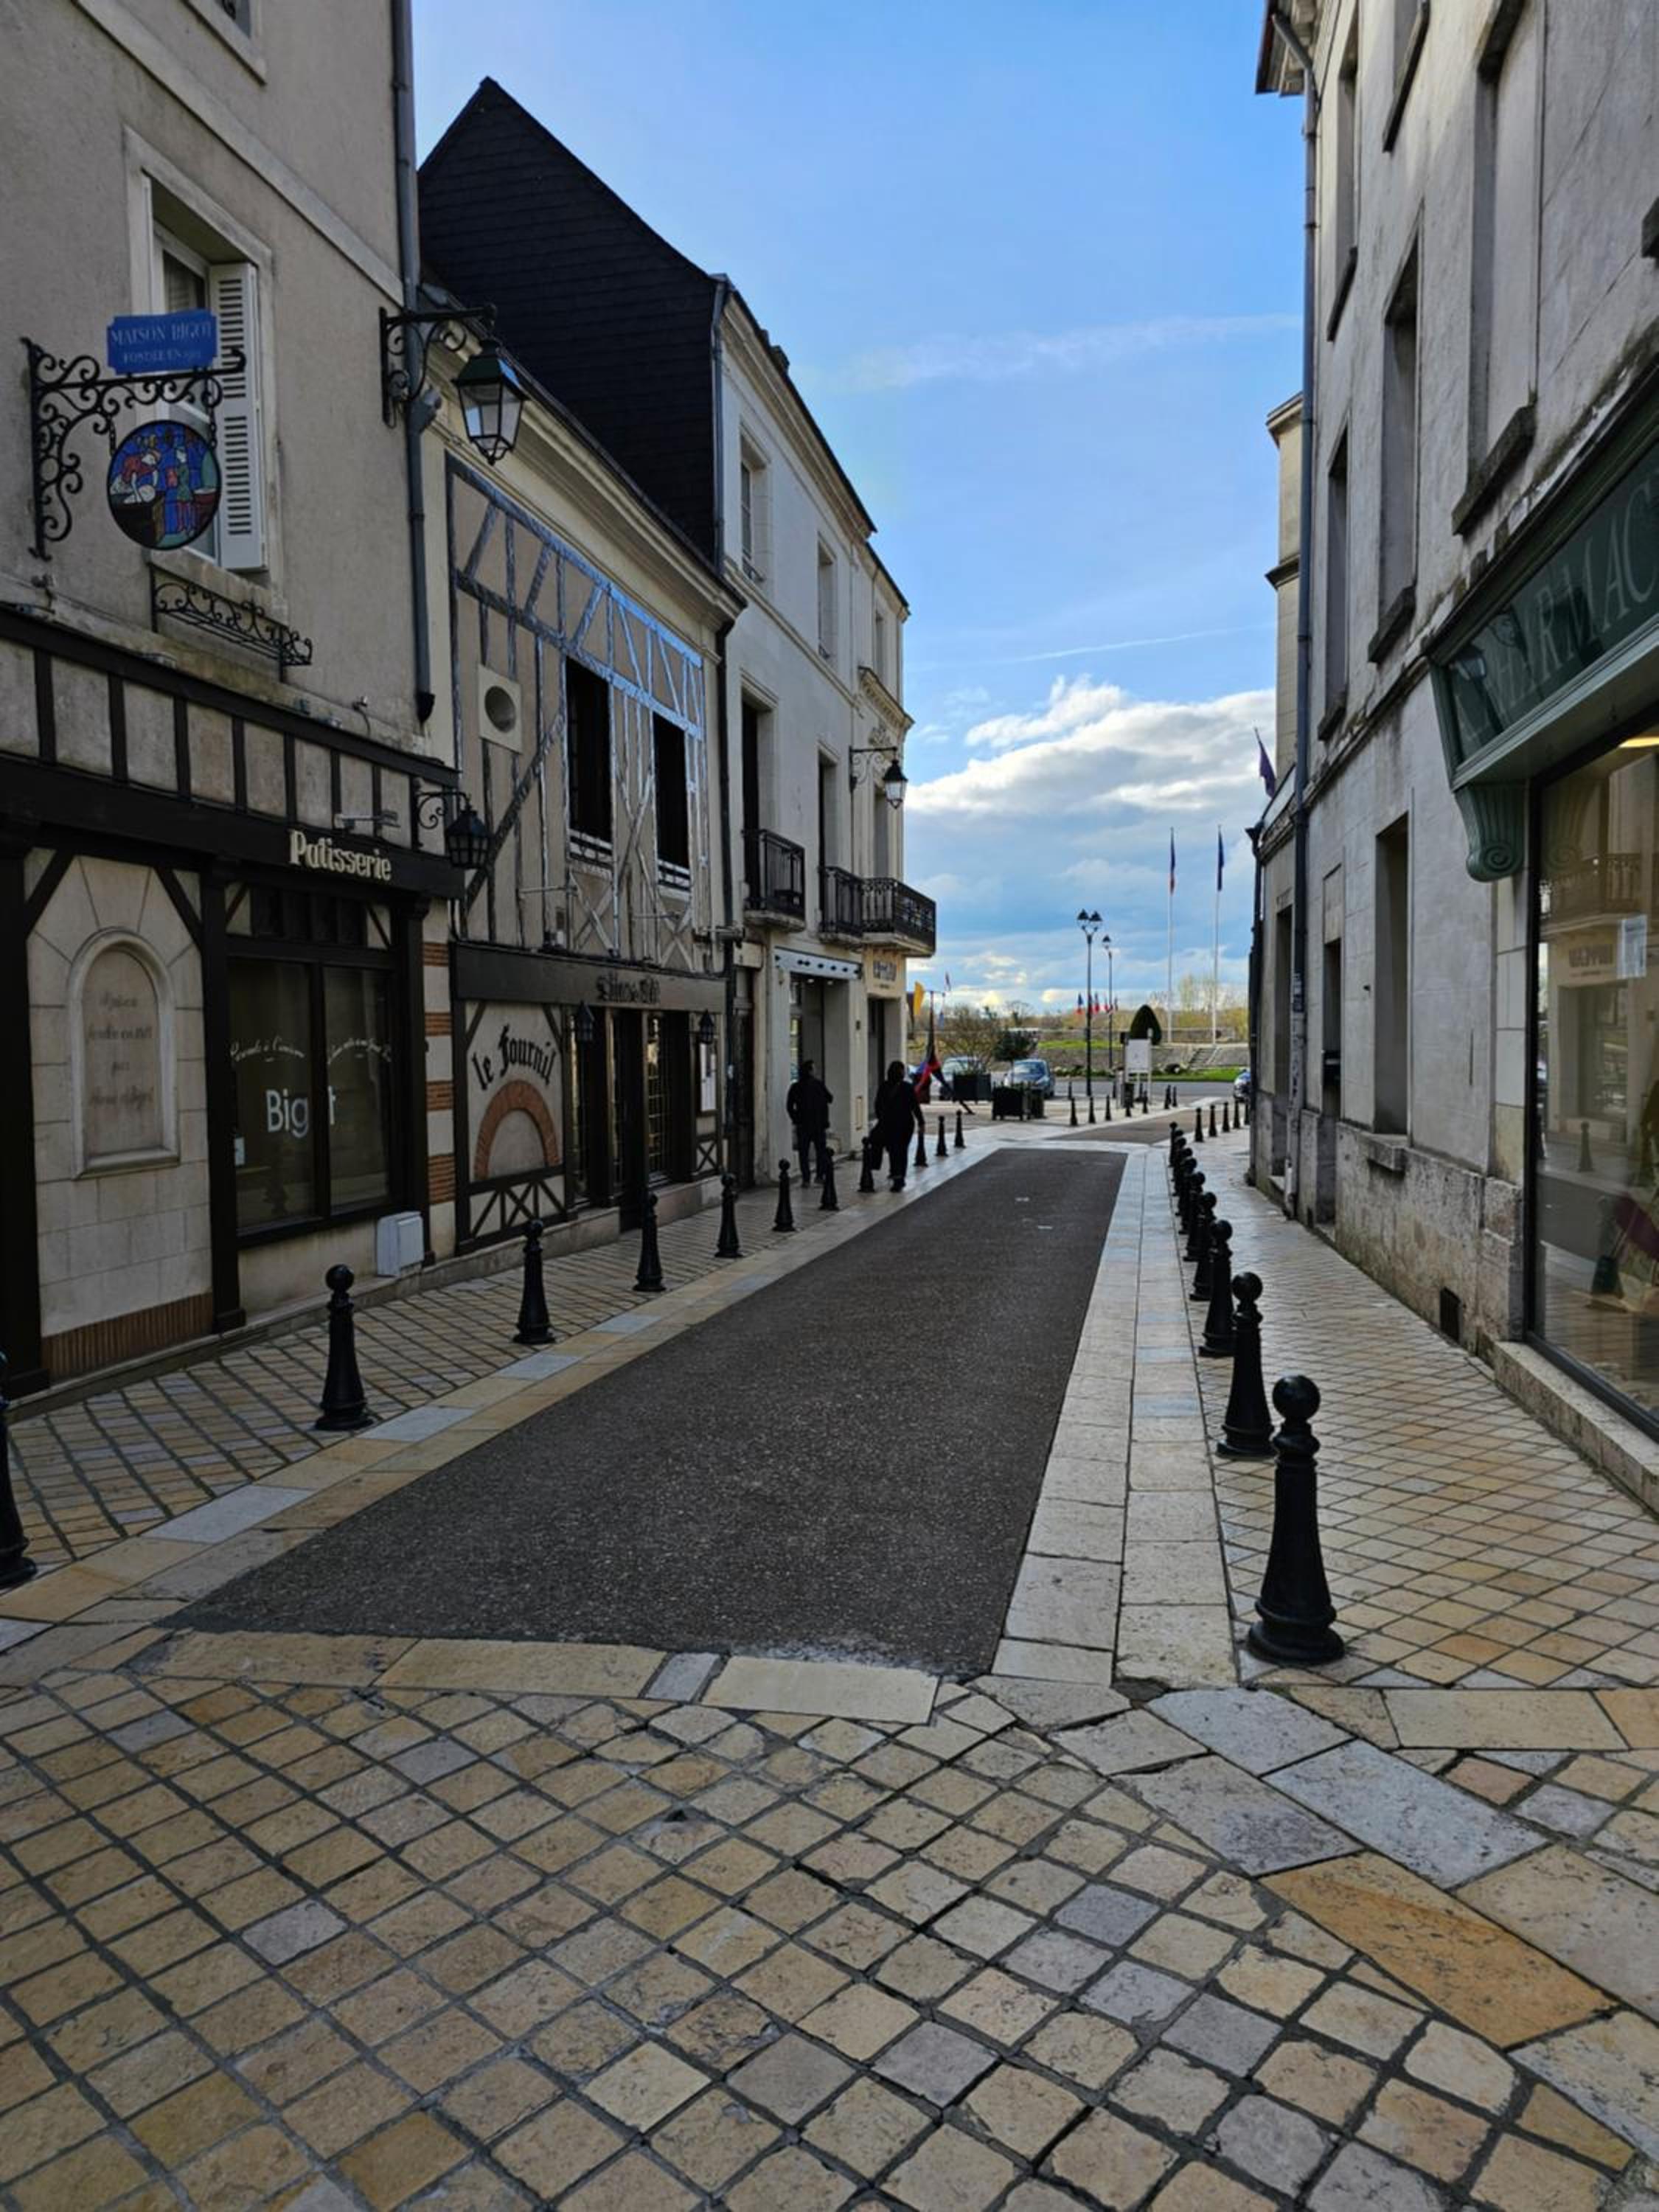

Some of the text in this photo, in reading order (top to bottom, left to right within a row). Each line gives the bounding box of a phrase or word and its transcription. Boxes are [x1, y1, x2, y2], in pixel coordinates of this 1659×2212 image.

[111, 321, 212, 346] MAISON BIGOT
[266, 1088, 336, 1138] Bigt
